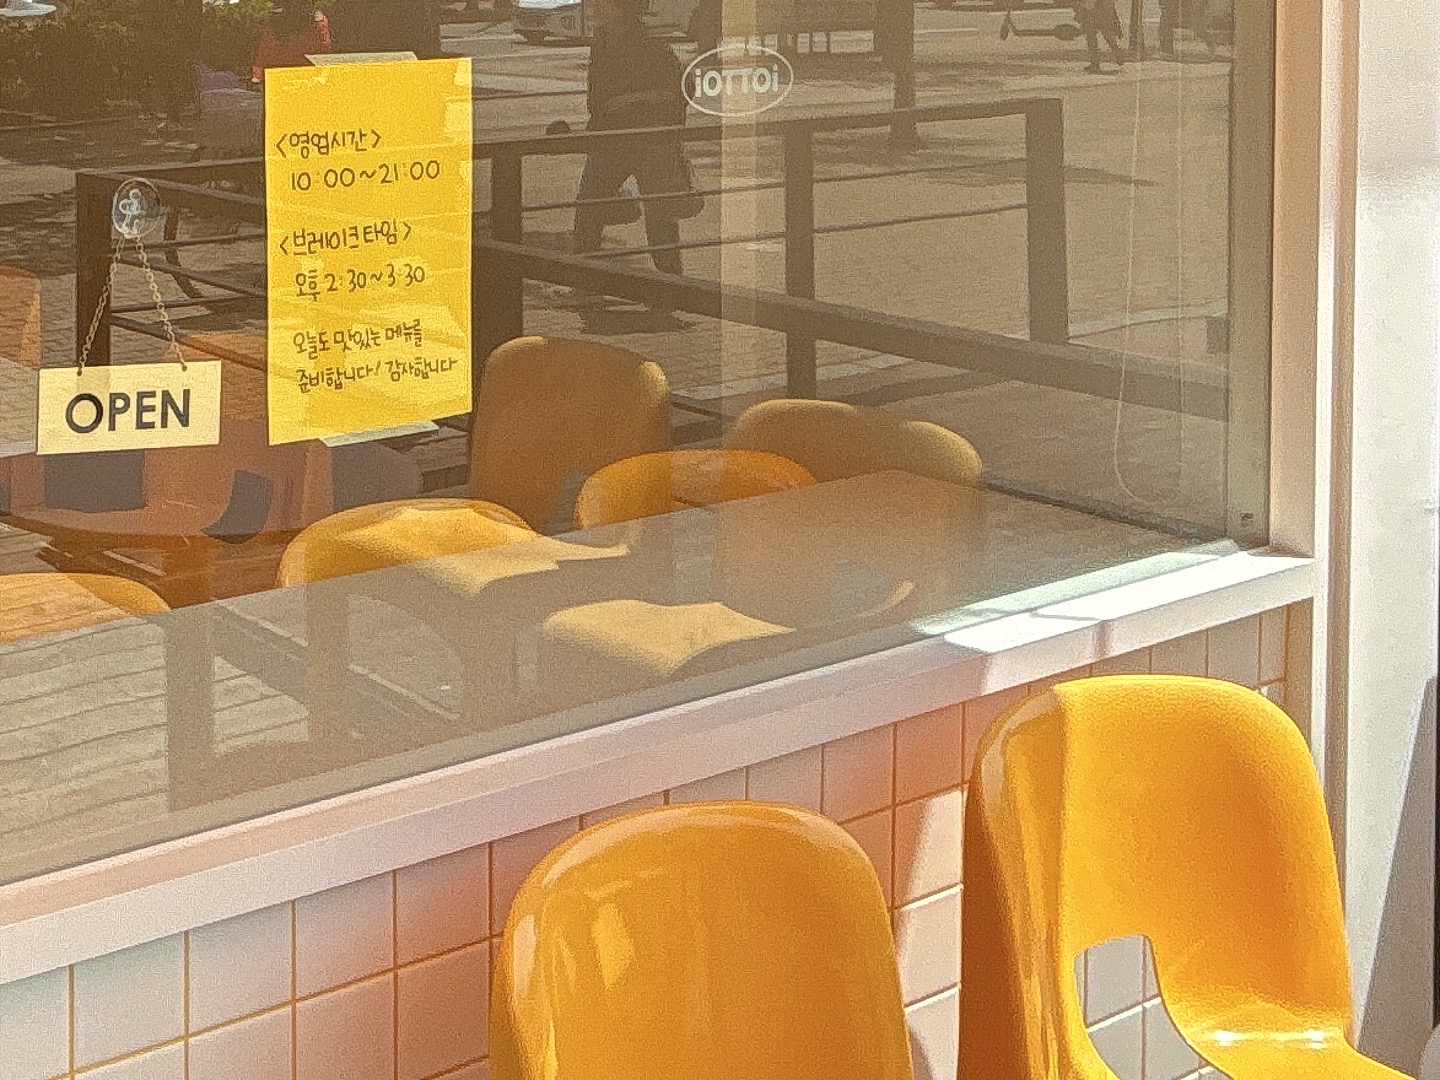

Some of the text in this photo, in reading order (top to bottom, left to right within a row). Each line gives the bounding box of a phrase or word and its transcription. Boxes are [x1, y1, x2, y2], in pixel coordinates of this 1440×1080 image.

[295, 269, 321, 302] 오후
[293, 318, 422, 360] 오늘도 맛있는 메뉴를
[385, 357, 458, 382] 감사합니다
[65, 389, 191, 434] OPEN
